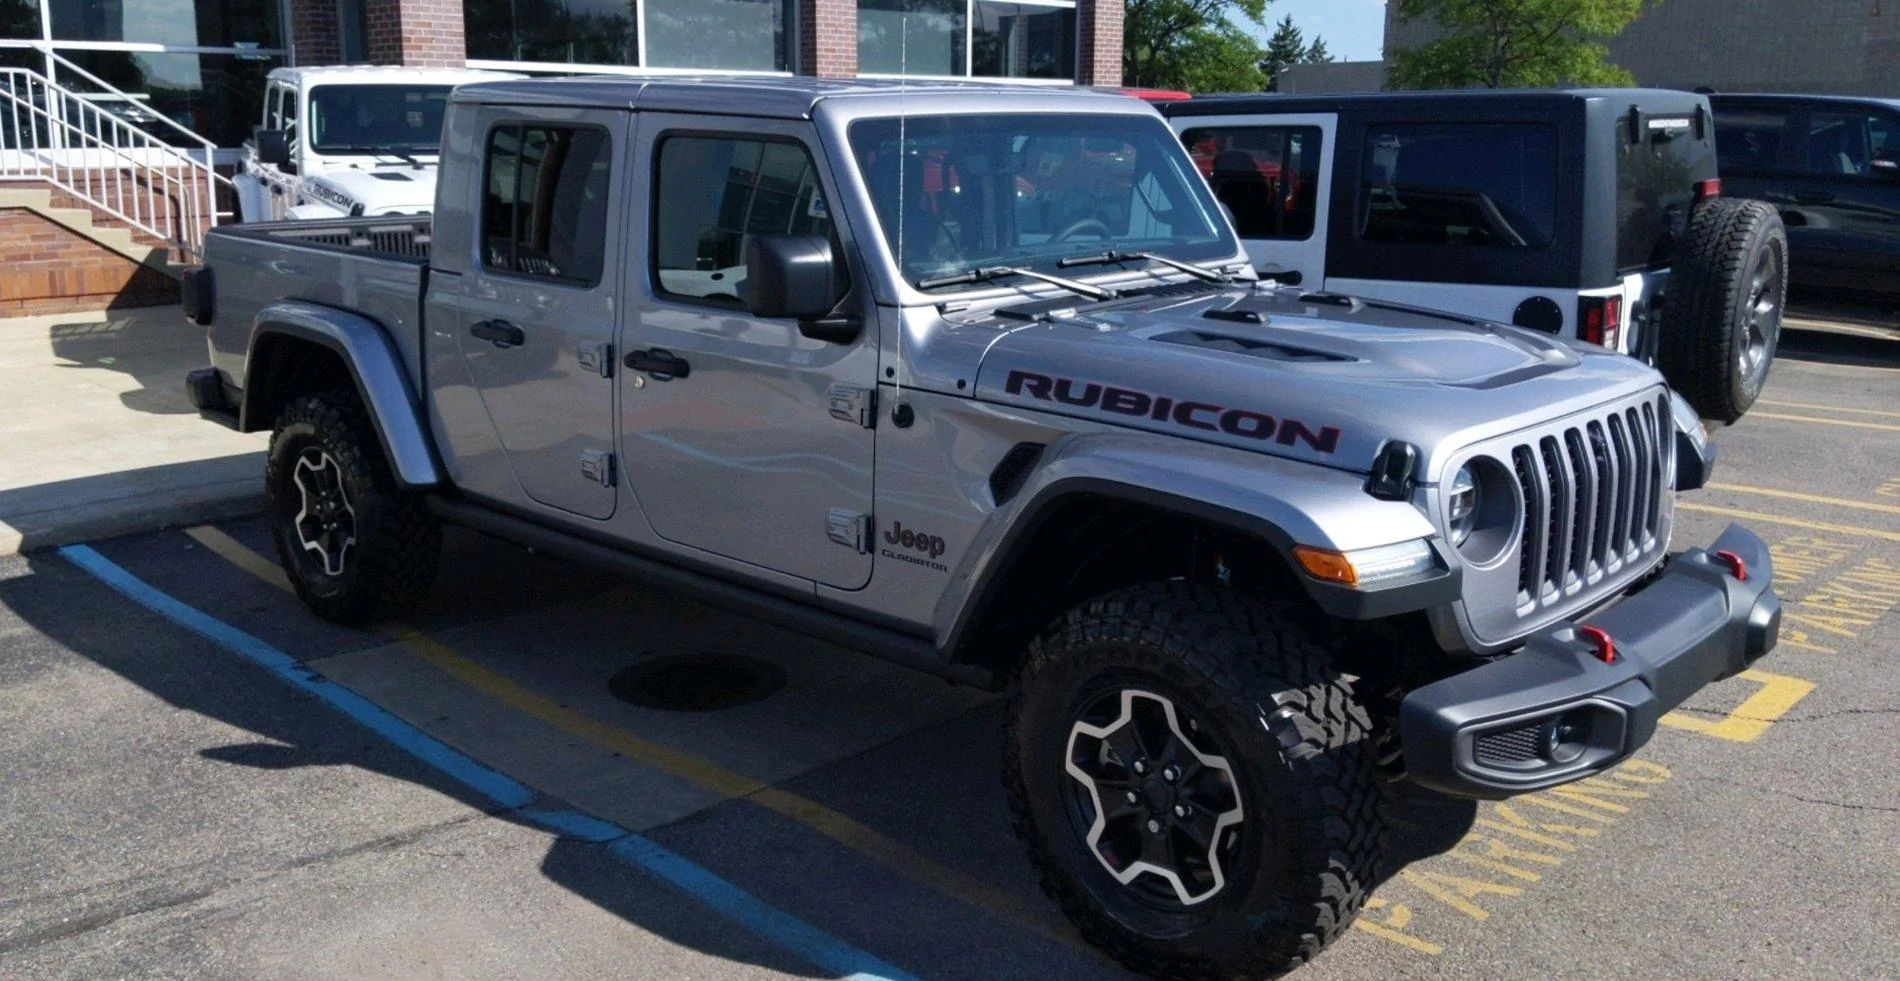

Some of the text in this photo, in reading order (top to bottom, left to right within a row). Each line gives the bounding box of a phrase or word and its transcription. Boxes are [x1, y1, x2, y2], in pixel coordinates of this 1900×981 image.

[313, 183, 354, 208] RUBICON
[1005, 370, 1341, 454] RUBICON
[884, 521, 945, 559] Jeep
[881, 549, 948, 572] GLADIATOR
[1352, 757, 1673, 955] PARKING
